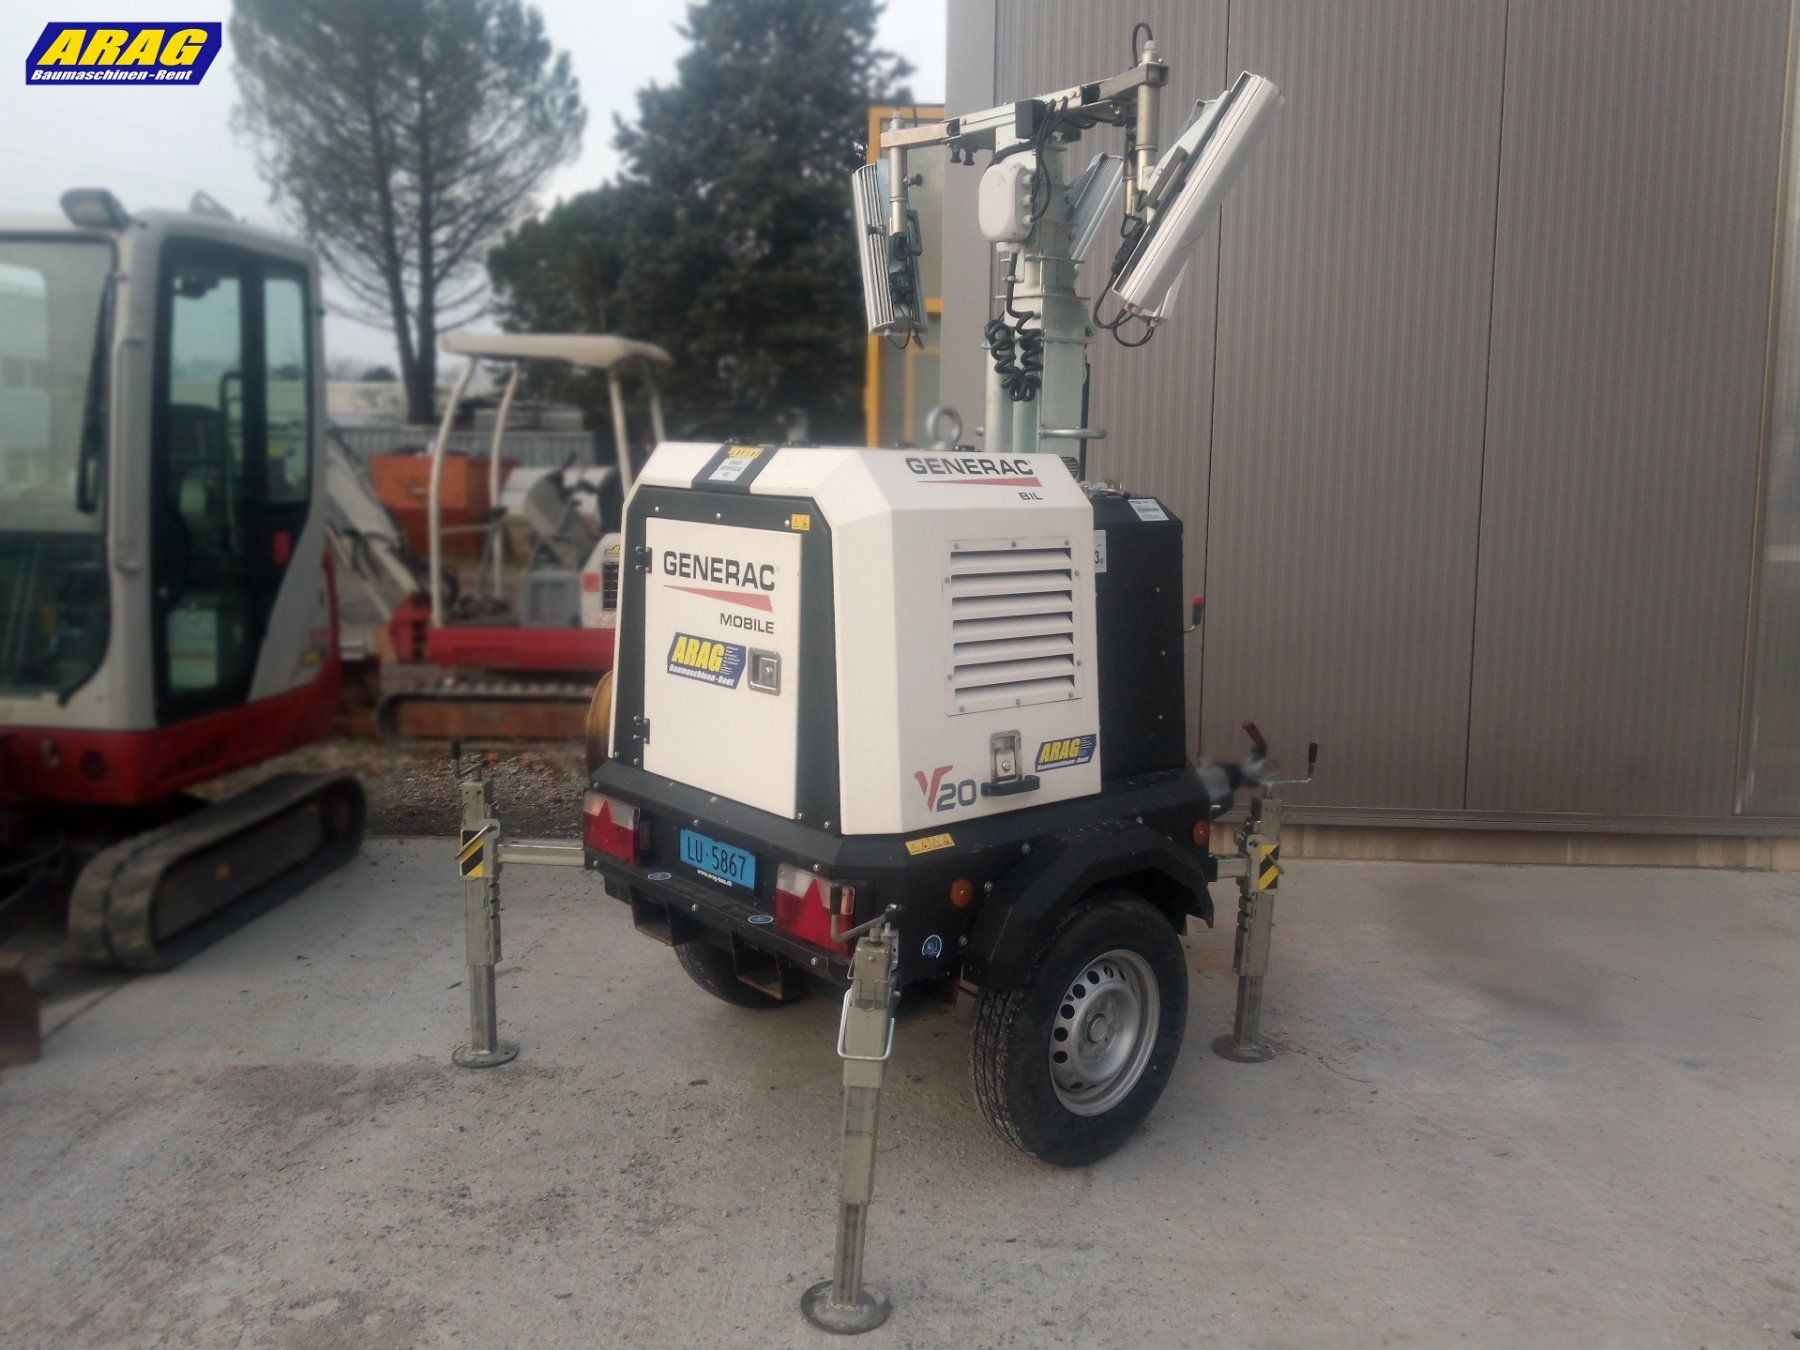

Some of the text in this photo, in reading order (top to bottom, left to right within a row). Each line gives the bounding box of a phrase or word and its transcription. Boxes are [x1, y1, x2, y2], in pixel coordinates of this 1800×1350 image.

[905, 457, 1035, 475] GENERAC
[663, 550, 776, 592] GENERAC
[720, 612, 775, 634] MOBILE
[671, 635, 725, 673] ARAG
[1038, 737, 1082, 764] ARAG
